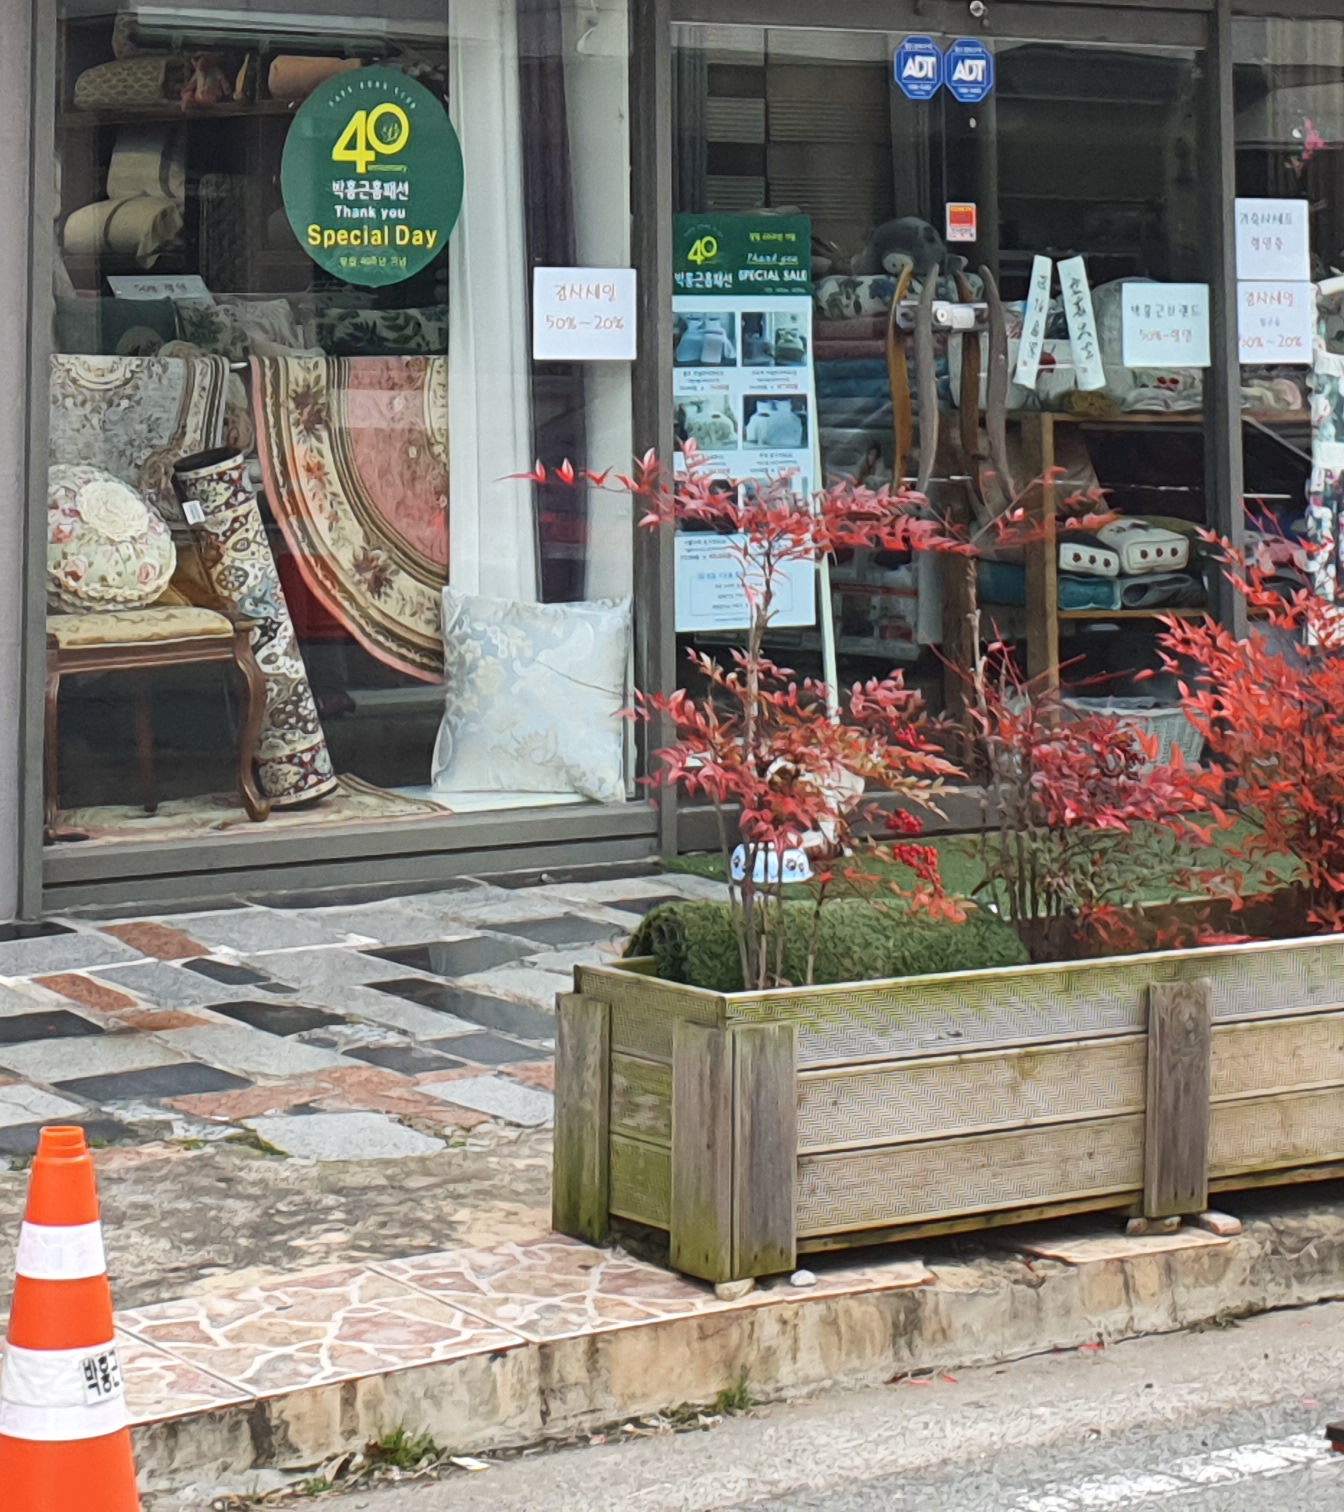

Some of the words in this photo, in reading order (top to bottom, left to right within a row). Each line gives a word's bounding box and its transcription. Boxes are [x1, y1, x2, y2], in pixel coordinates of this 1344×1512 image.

[901, 54, 937, 79] ADT
[952, 59, 987, 82] ADT
[331, 102, 410, 174] 40
[331, 179, 409, 201] 박홍근홈패션
[334, 205, 376, 219] Thank
[381, 206, 406, 220] you
[307, 224, 389, 249] Special
[395, 224, 438, 249] Day
[687, 235, 718, 265] 40
[783, 269, 808, 282] SALE
